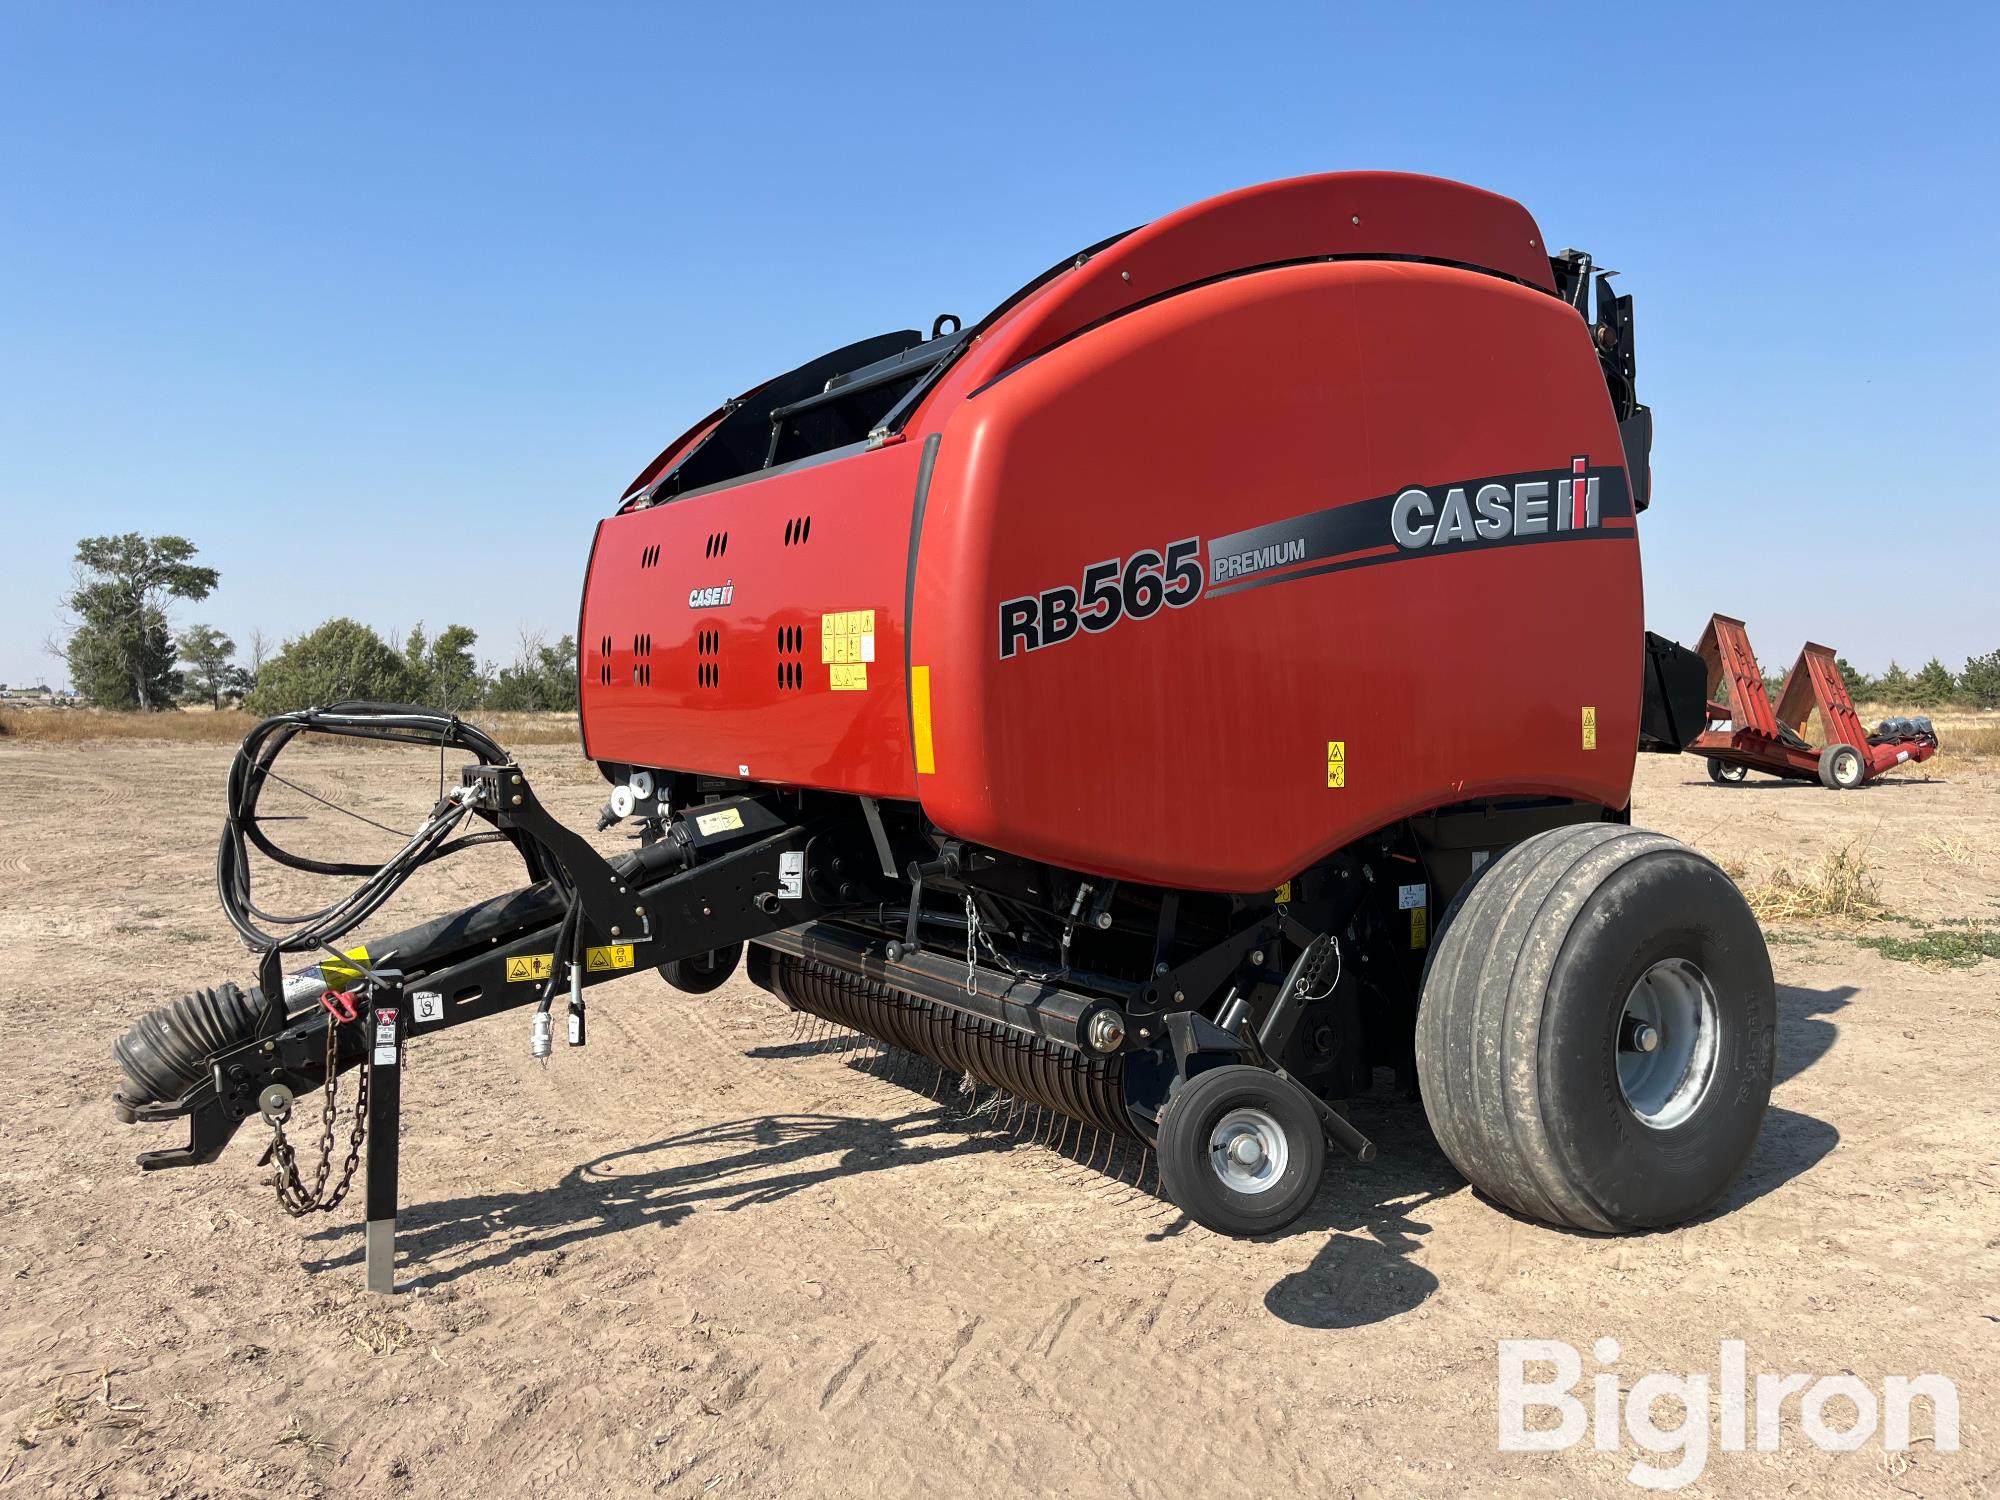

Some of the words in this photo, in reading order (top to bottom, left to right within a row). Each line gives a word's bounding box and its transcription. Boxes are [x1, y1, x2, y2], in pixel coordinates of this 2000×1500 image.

[1391, 480, 1549, 549] CASE
[689, 587, 721, 607] CASE
[999, 536, 1205, 660] RB565
[1214, 538, 1306, 581] PREMIUM
